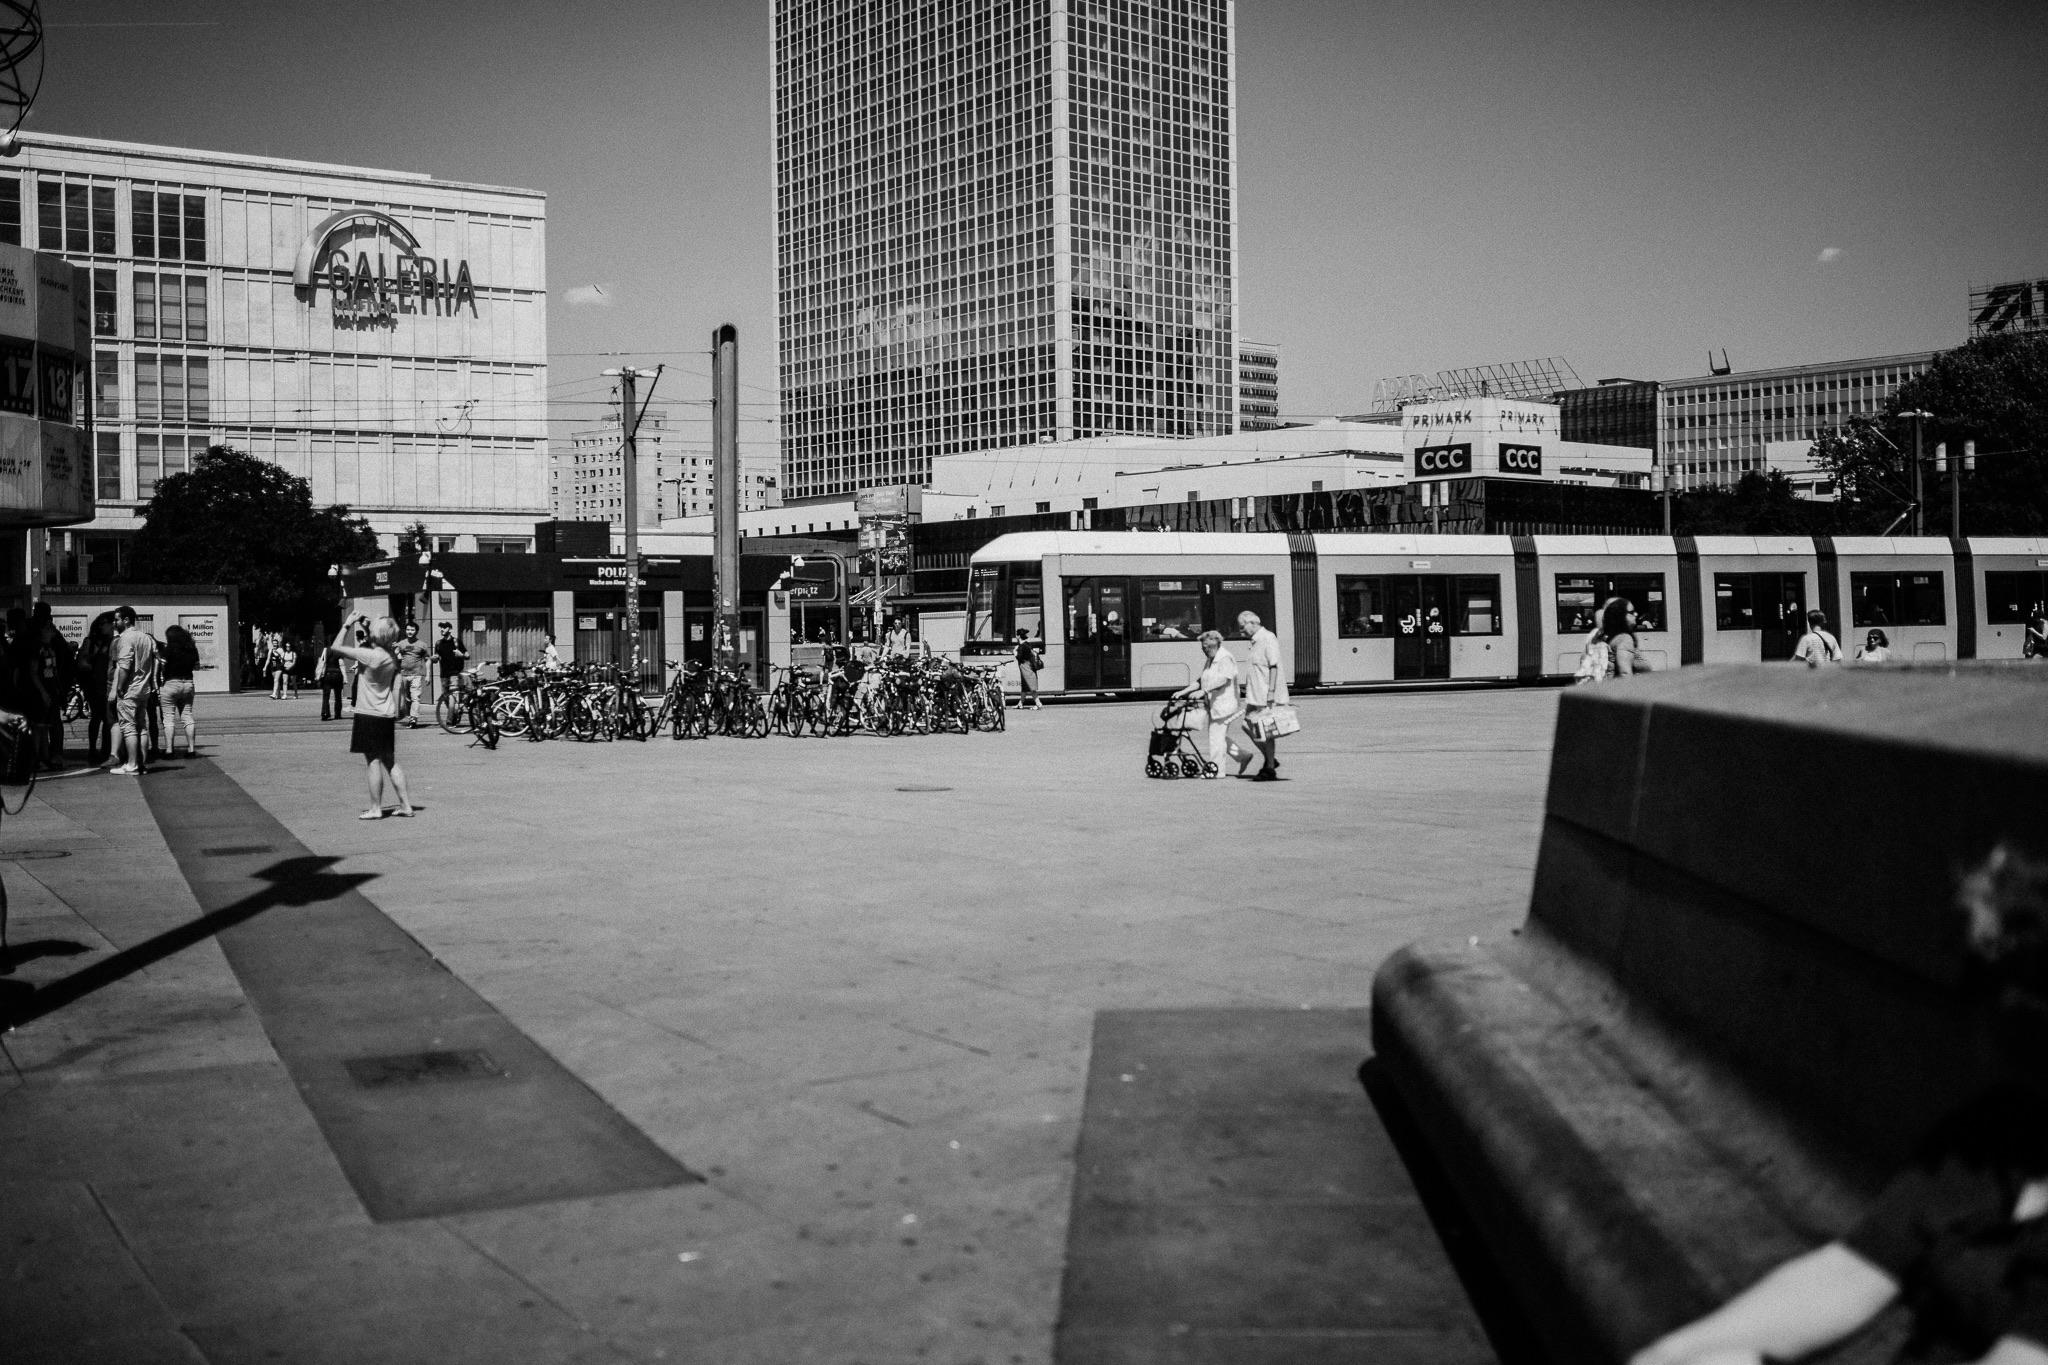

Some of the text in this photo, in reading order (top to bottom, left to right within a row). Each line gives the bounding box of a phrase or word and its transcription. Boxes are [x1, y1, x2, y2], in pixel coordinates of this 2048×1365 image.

[328, 250, 475, 298] GALERIA
[47, 366, 67, 408] 18
[1413, 410, 1472, 428] PRIMARK
[1500, 410, 1545, 427] PRIMARK
[1421, 449, 1463, 470] CCC
[1505, 448, 1538, 469] CCC
[598, 567, 627, 577] POLIZ
